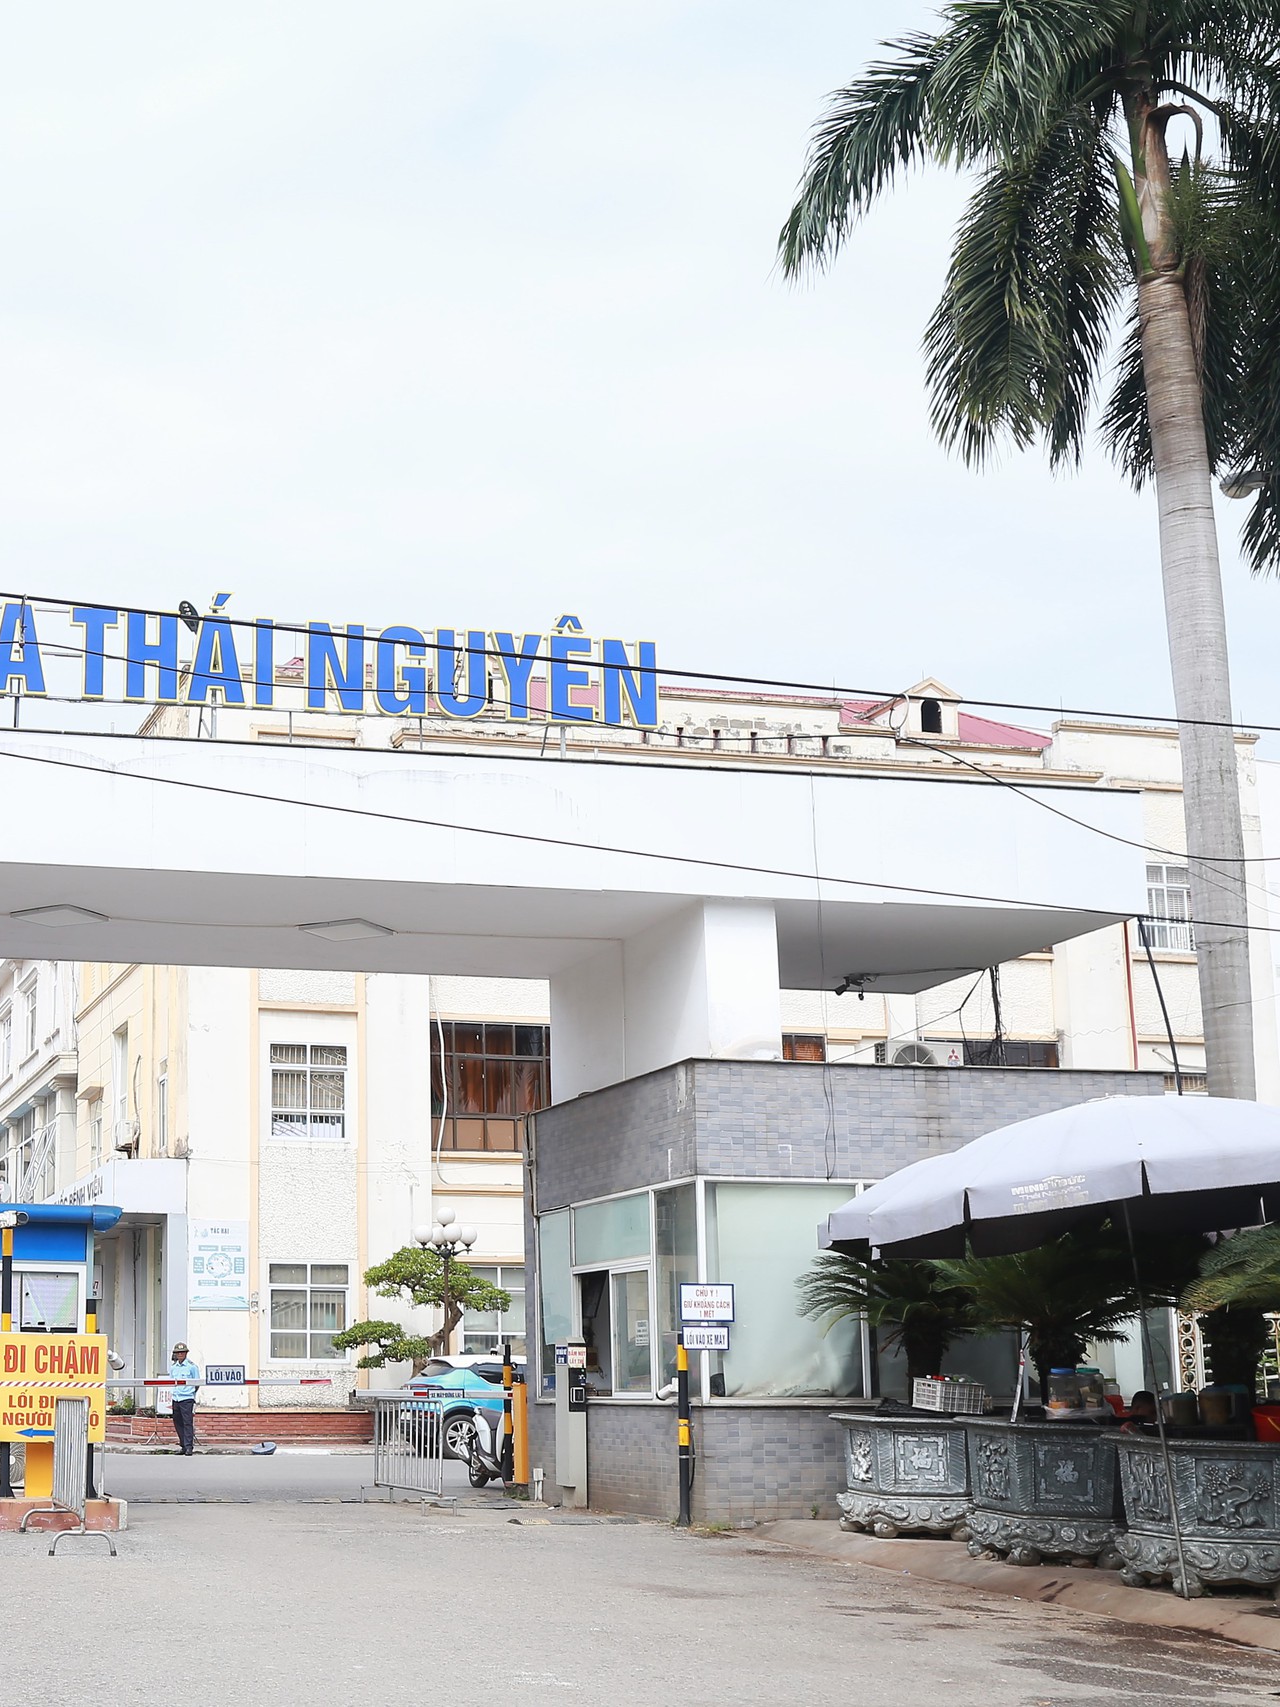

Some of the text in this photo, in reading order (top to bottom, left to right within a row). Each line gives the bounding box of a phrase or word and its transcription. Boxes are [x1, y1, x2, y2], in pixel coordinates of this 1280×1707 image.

[70, 592, 274, 709] THÁI
[305, 614, 658, 729] NGUYÊN
[707, 1334, 713, 1345] XE
[4, 1340, 99, 1379] ĐI CHẬM
[210, 1368, 241, 1381] LỐI VÀO
[9, 1389, 54, 1409] LỐI ĐI
[3, 1410, 52, 1426] NGƯỜI
